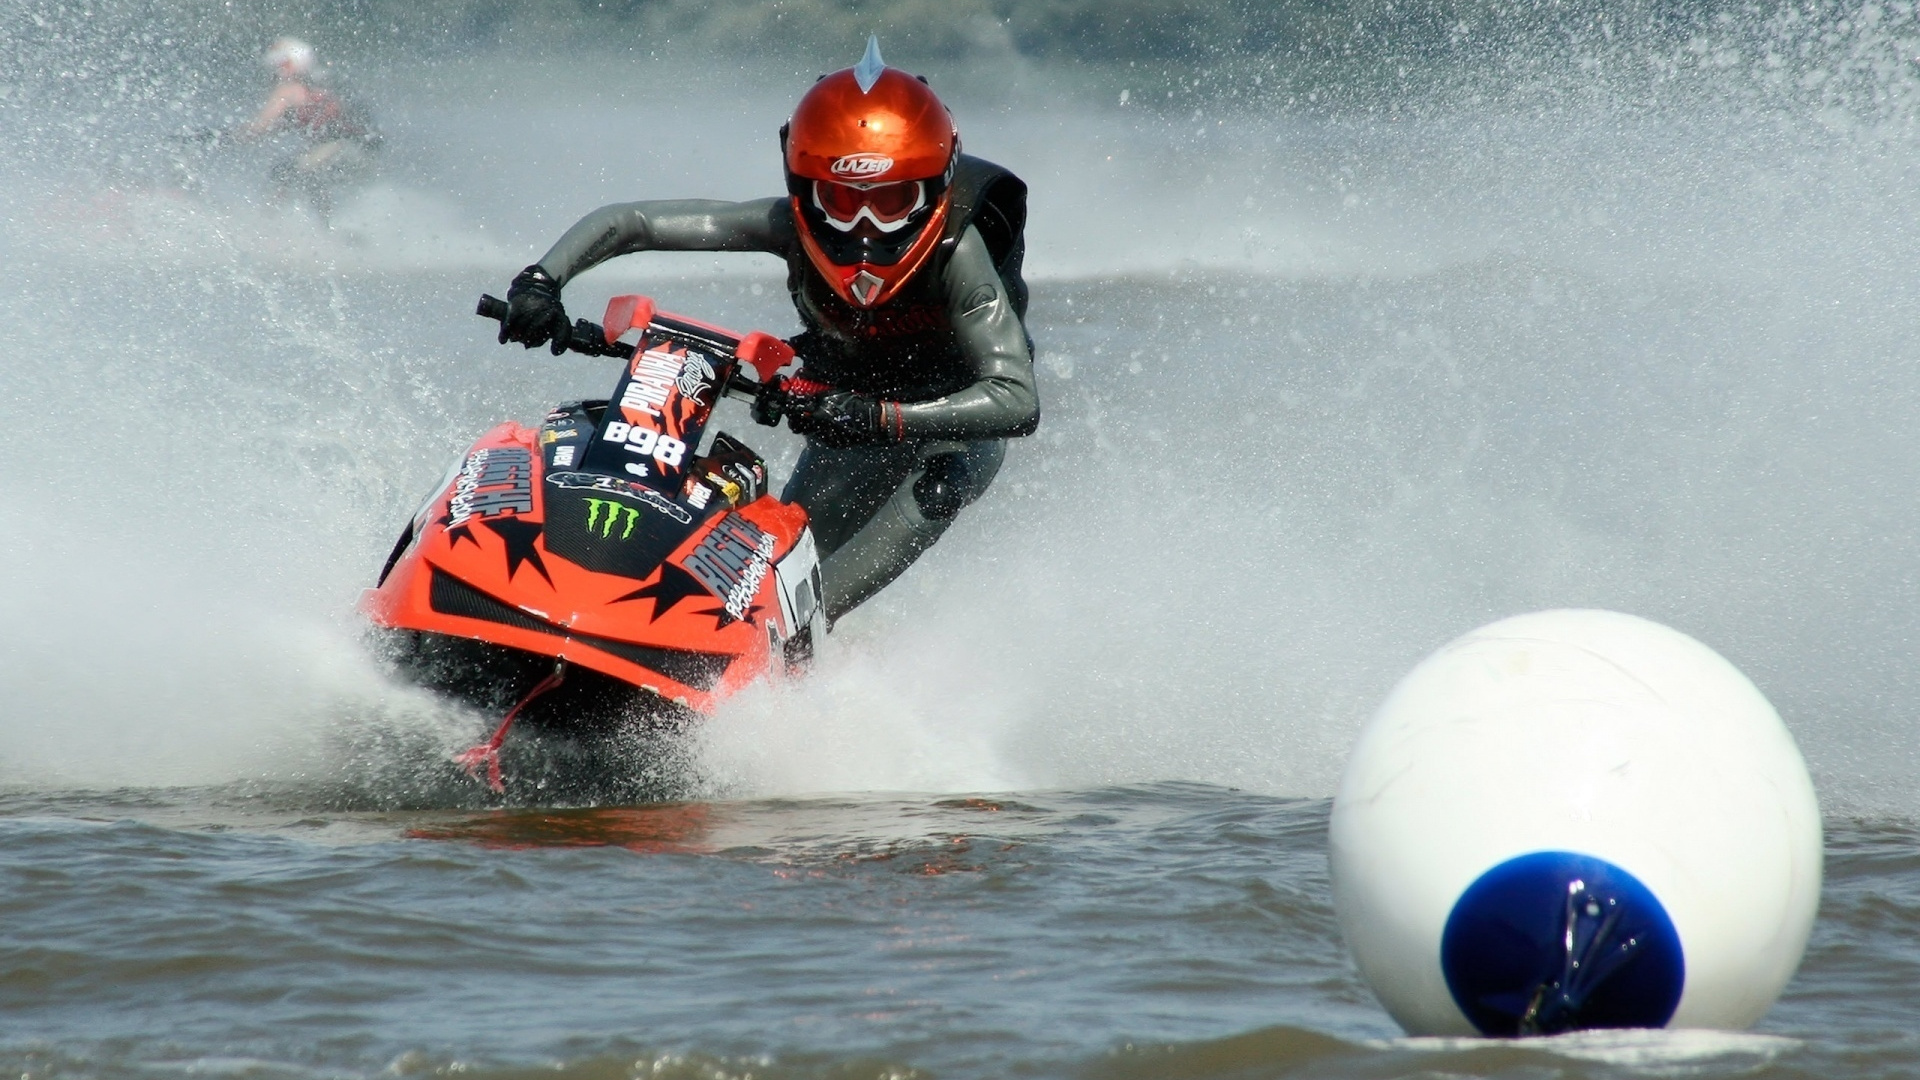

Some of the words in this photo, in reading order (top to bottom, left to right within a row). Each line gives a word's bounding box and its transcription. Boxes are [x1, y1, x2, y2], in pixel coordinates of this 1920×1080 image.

[836, 157, 890, 174] LAZER
[620, 350, 686, 417] PIRANHA
[603, 421, 687, 466] B98
[687, 482, 712, 510] uvex
